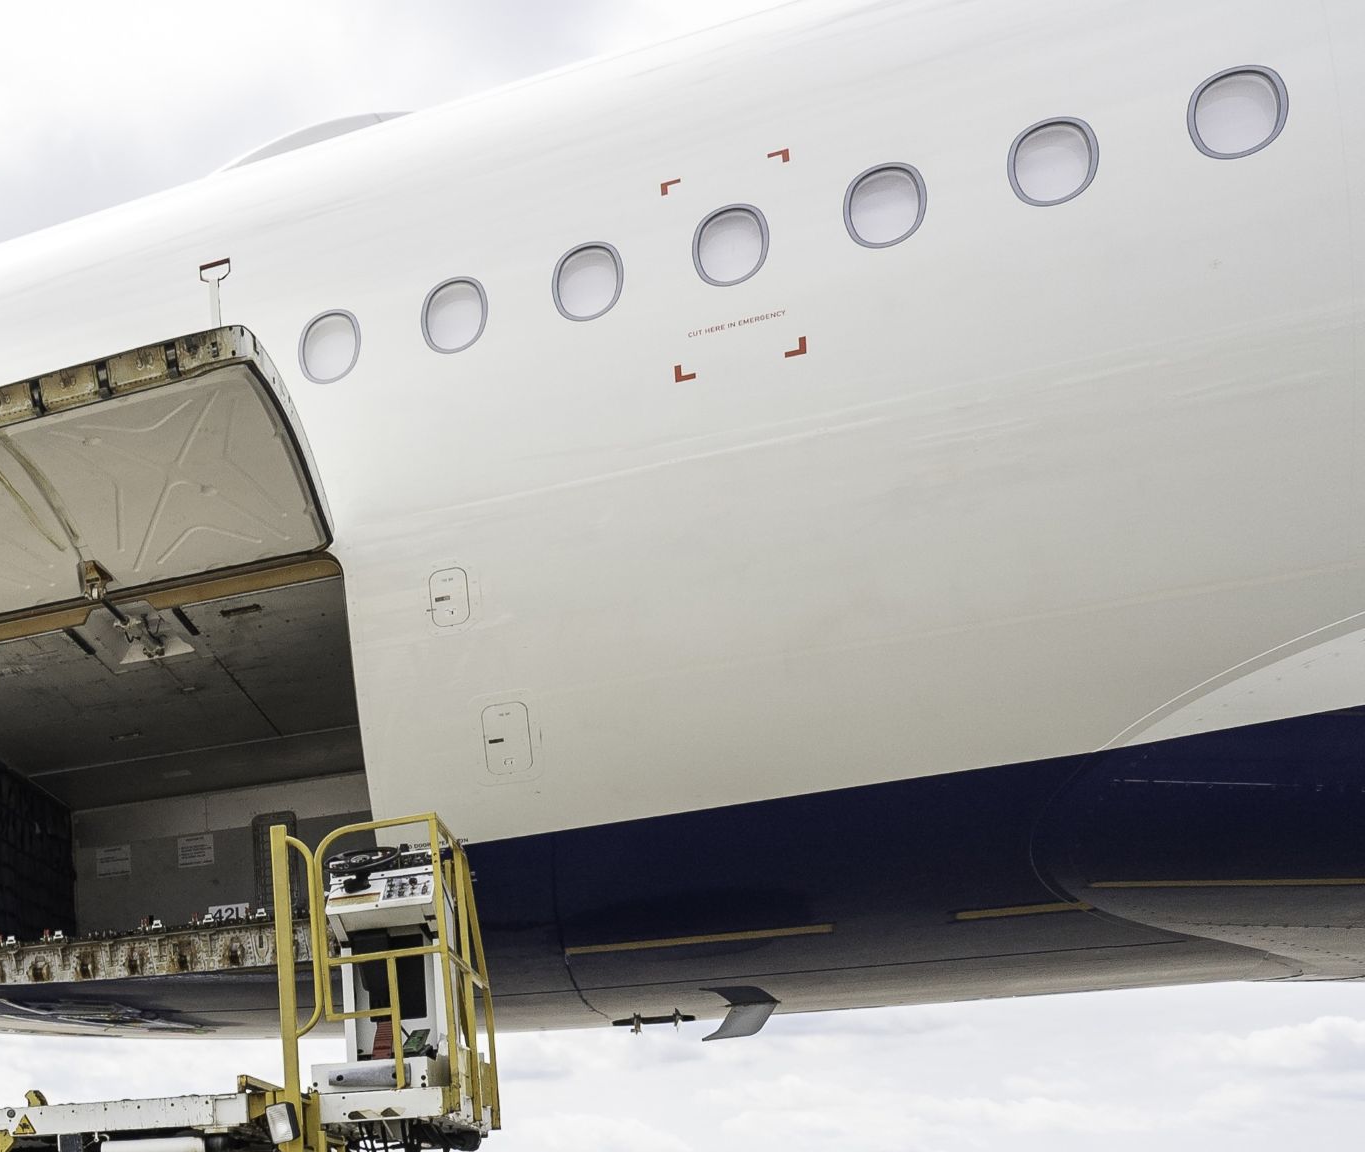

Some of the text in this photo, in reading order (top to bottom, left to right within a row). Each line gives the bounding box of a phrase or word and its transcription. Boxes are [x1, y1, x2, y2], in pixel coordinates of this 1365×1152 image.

[688, 310, 786, 338] CUT HERE IN EMERGENCY
